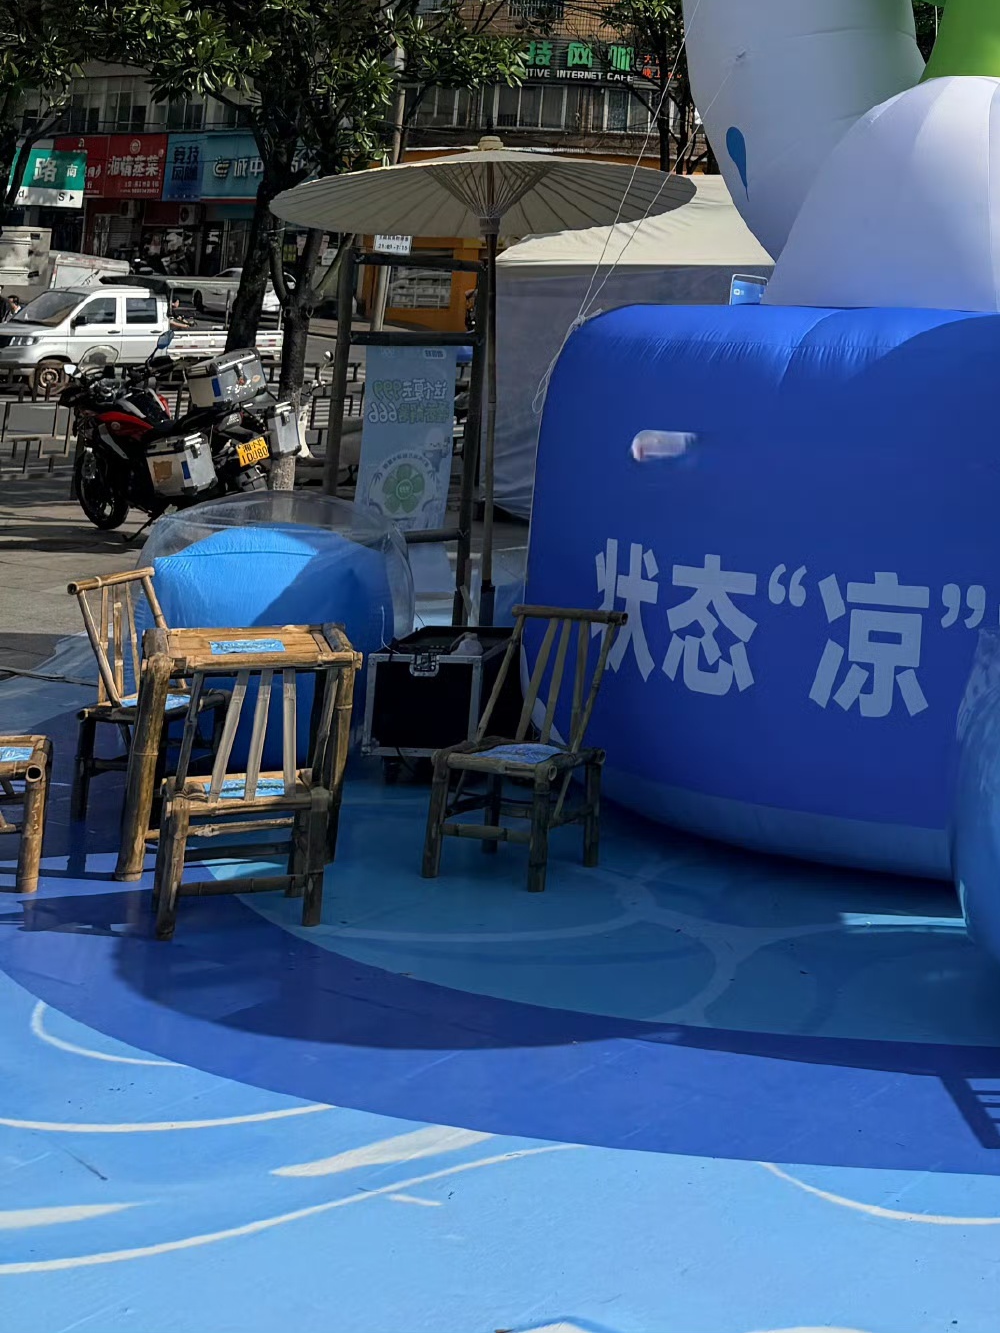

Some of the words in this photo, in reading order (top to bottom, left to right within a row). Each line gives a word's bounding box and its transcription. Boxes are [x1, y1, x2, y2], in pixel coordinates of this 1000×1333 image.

[525, 67, 550, 79] ITIVE
[556, 69, 603, 81] INTERNET
[33, 157, 57, 182] 路
[66, 163, 79, 178] 南
[58, 192, 65, 202] S
